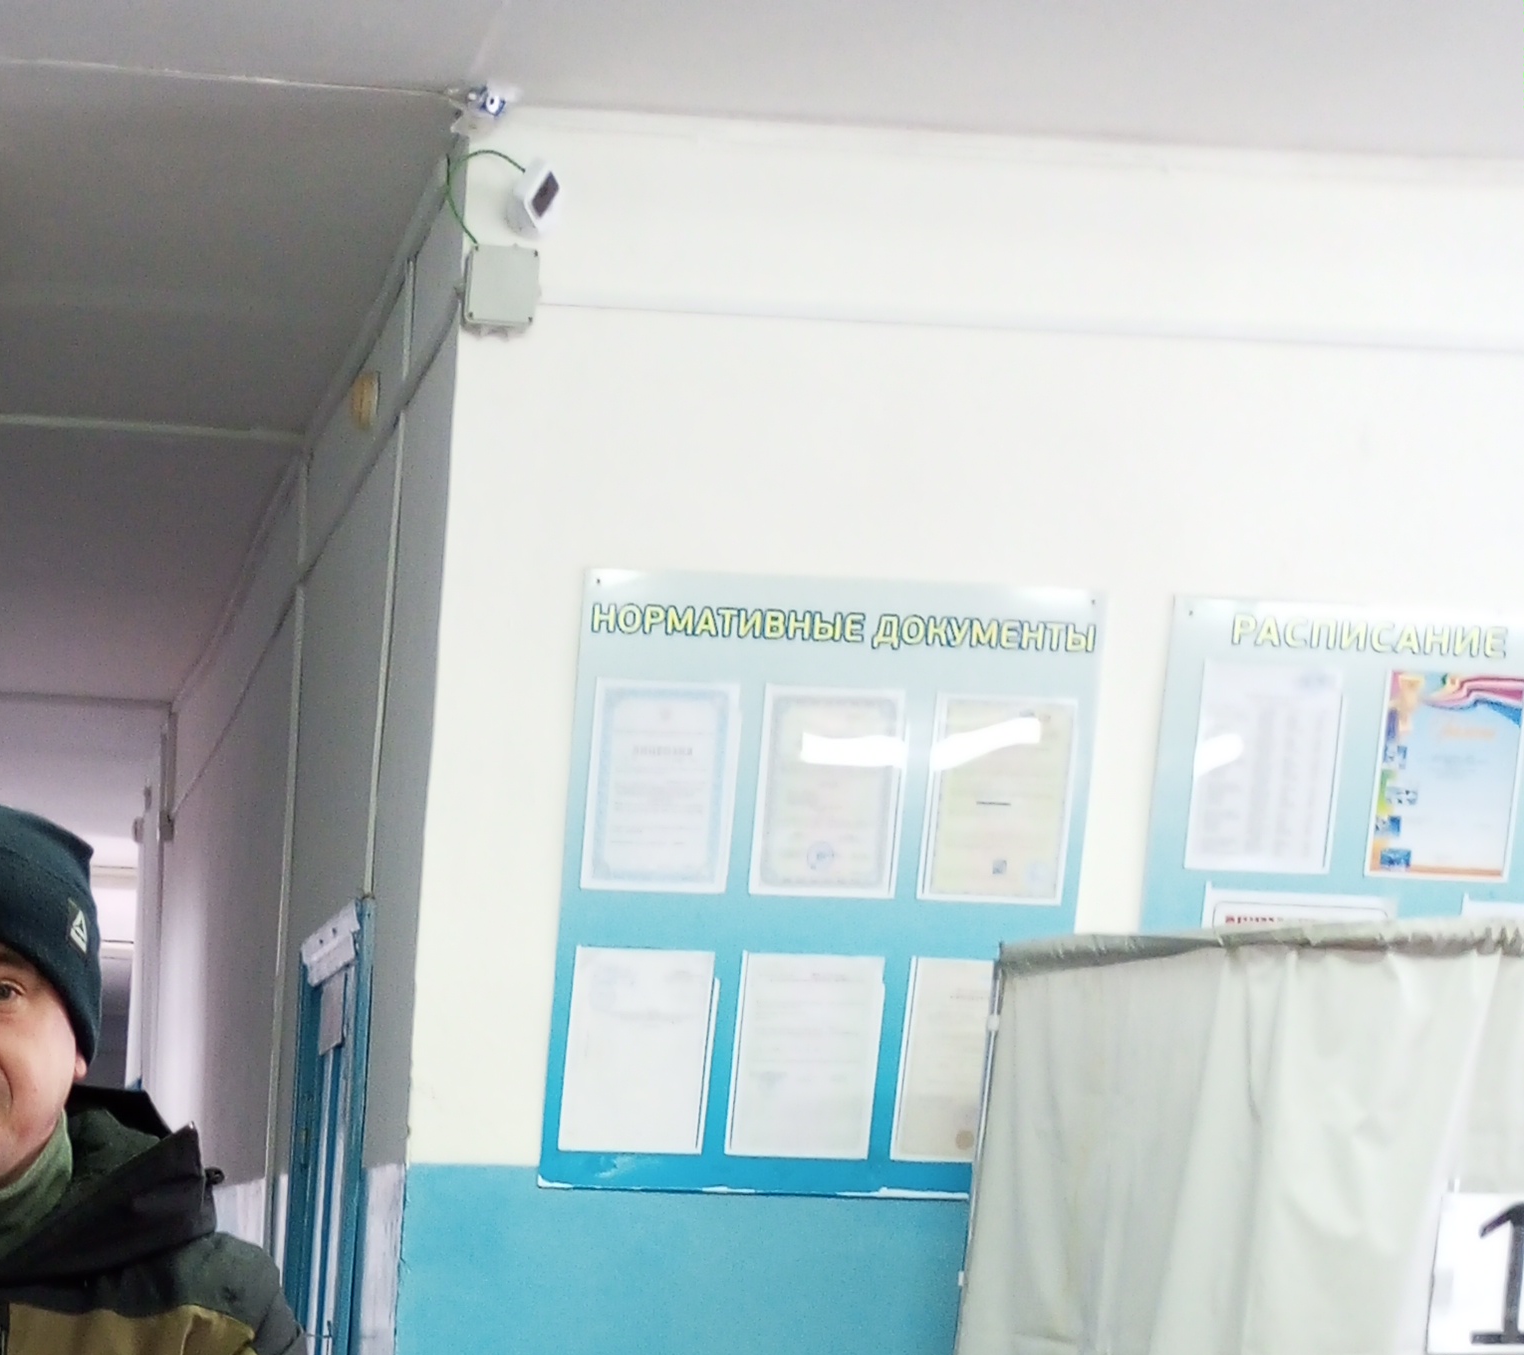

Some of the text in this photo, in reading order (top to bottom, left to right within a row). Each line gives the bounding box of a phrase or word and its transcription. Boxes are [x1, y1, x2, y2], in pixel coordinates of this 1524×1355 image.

[591, 603, 1096, 653] НОРМАТИВНЫЕ ДОКУМЕНТЫ
[1230, 611, 1509, 658] РАСПИСАНИЕ
[1470, 1201, 1524, 1345] 1
